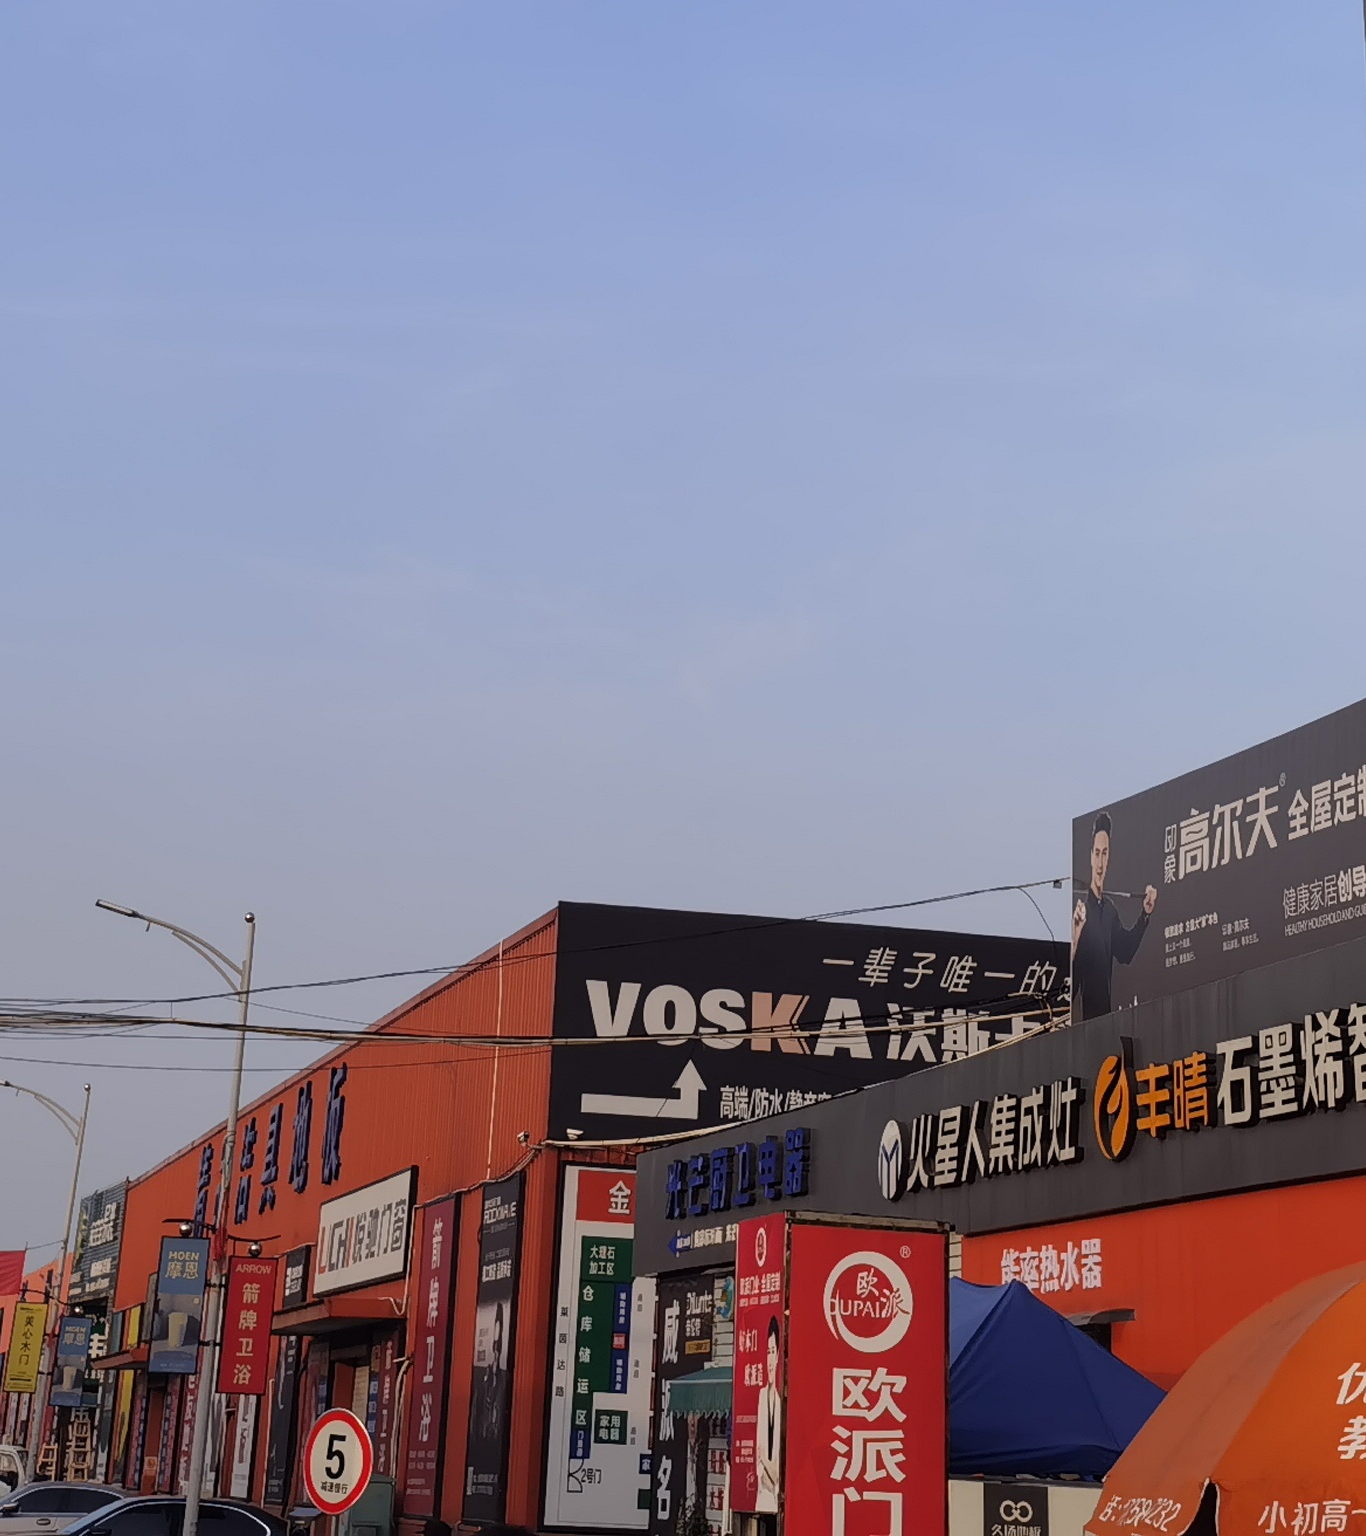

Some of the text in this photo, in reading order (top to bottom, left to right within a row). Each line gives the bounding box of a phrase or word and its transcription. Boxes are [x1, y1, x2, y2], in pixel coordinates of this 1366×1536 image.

[1164, 825, 1176, 884] 印象
[1178, 786, 1279, 880] 高尔夫
[586, 980, 873, 1060] VOSKA
[1135, 1051, 1210, 1138] 丰晴
[906, 1080, 1085, 1193] 火星人集成灶
[608, 1180, 630, 1215] 金
[165, 1261, 199, 1281] 摩恩
[168, 1250, 200, 1262] MOEN
[235, 1263, 272, 1275] ARROW
[589, 1245, 615, 1260] 大理石
[589, 1261, 615, 1276] 加工区
[1001, 1238, 1102, 1298] 能率热水器
[18, 1315, 35, 1366] 美心木门
[232, 1282, 261, 1386] 箭牌卫浴
[418, 1216, 443, 1442] 箭牌卫浴
[575, 1285, 594, 1426] 仓库储运区
[600, 1414, 620, 1428] 家用
[325, 1434, 347, 1480] 5
[581, 1468, 602, 1485] 2号门
[830, 1367, 907, 1536] 欧派门
